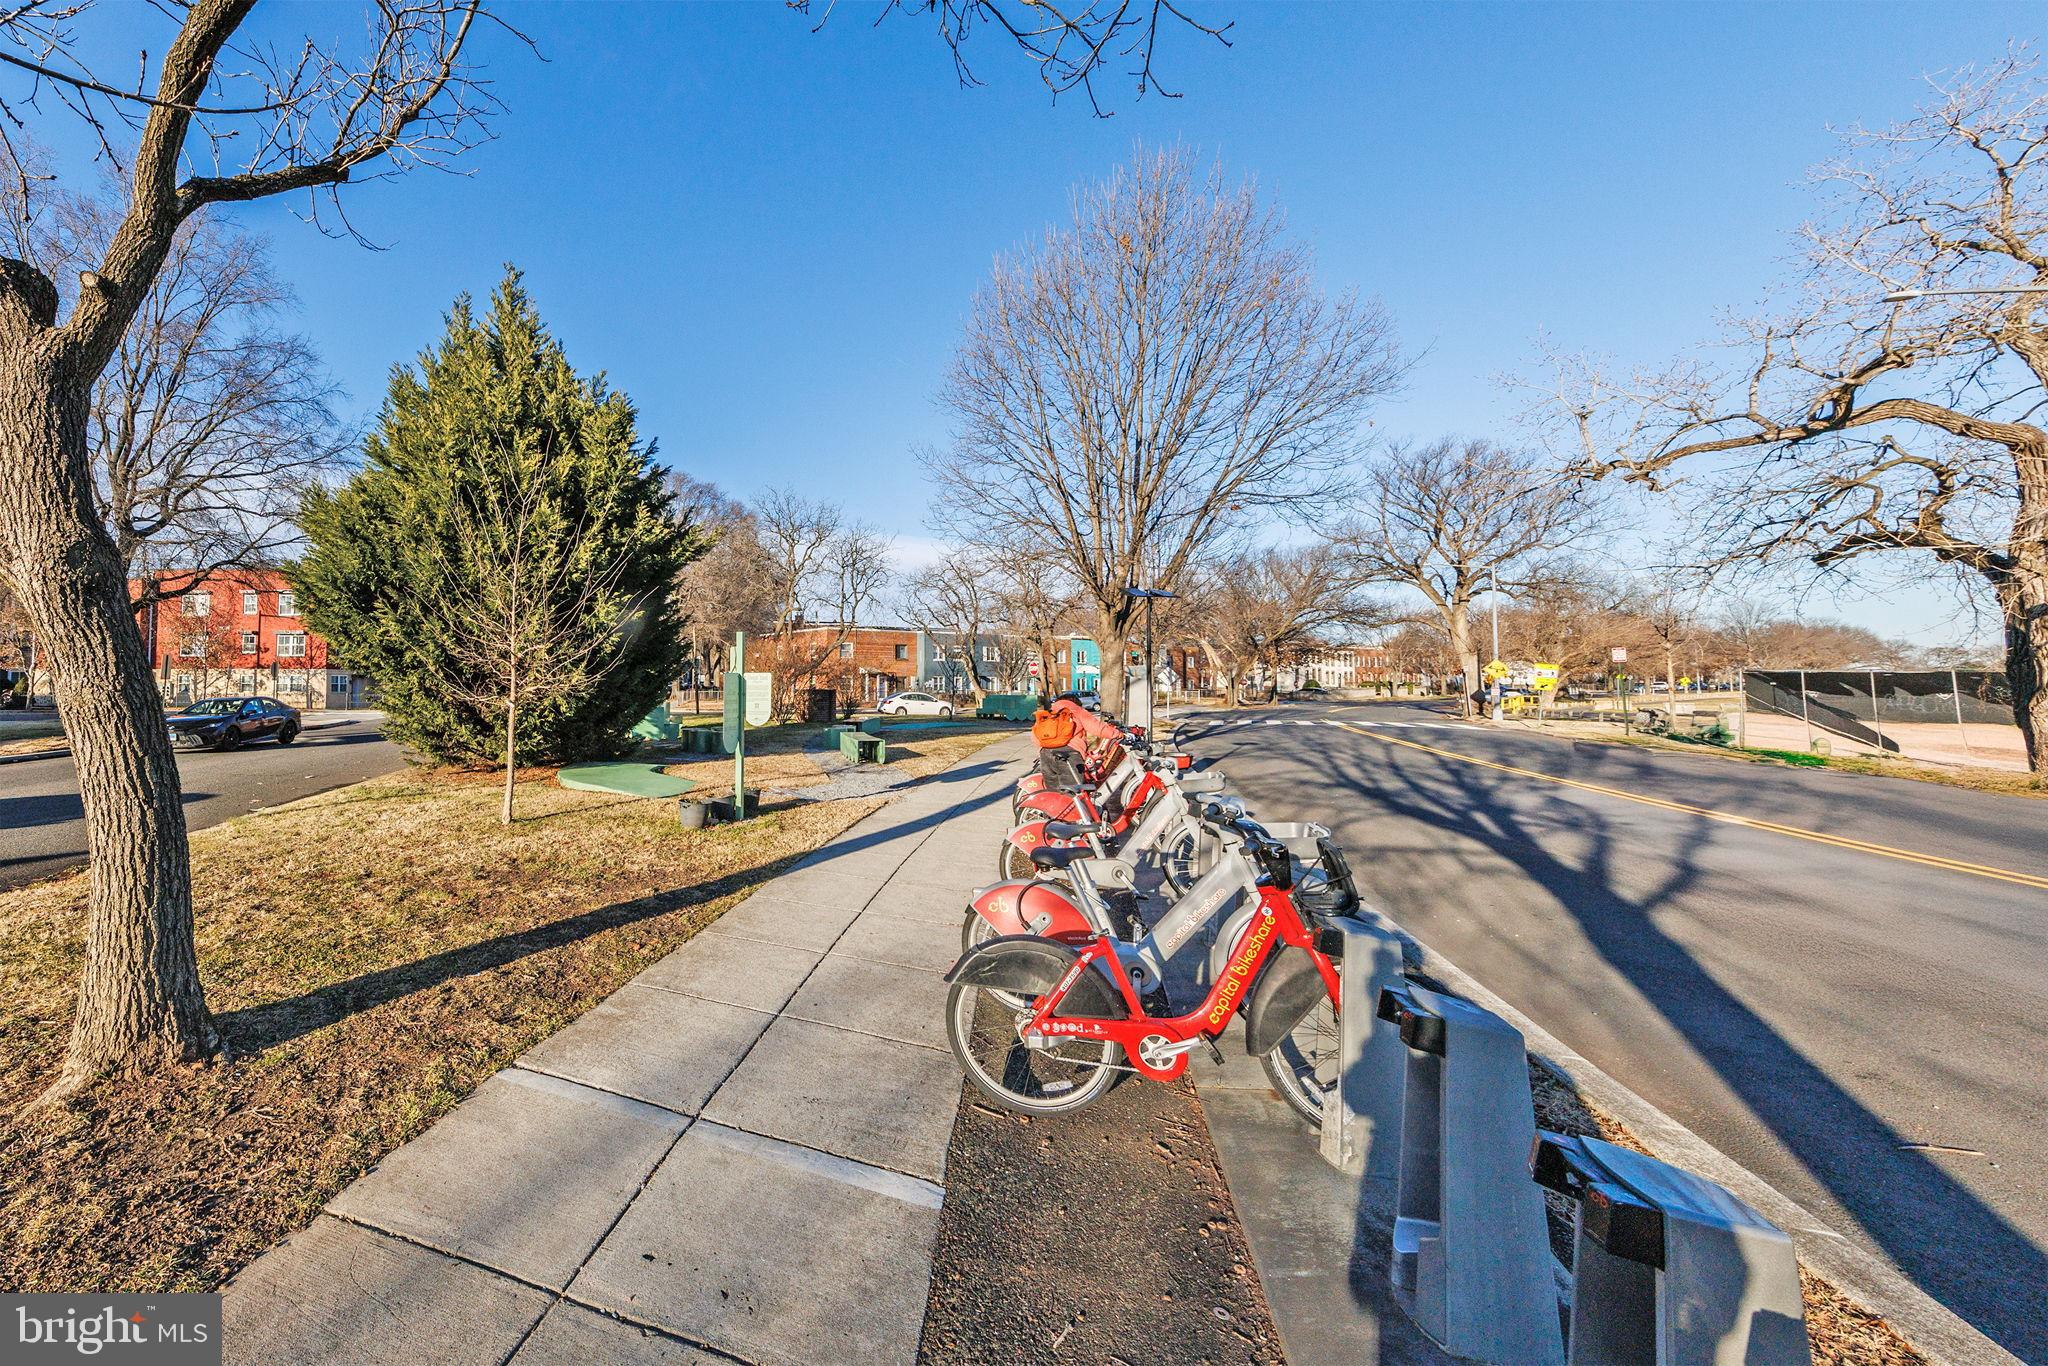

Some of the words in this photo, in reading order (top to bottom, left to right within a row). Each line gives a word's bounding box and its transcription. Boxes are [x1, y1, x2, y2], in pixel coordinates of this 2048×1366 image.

[1166, 917, 1192, 949] capital
[1188, 888, 1227, 923] bikeshare
[1209, 975, 1241, 1025] capital
[1230, 915, 1276, 976] bikeshare
